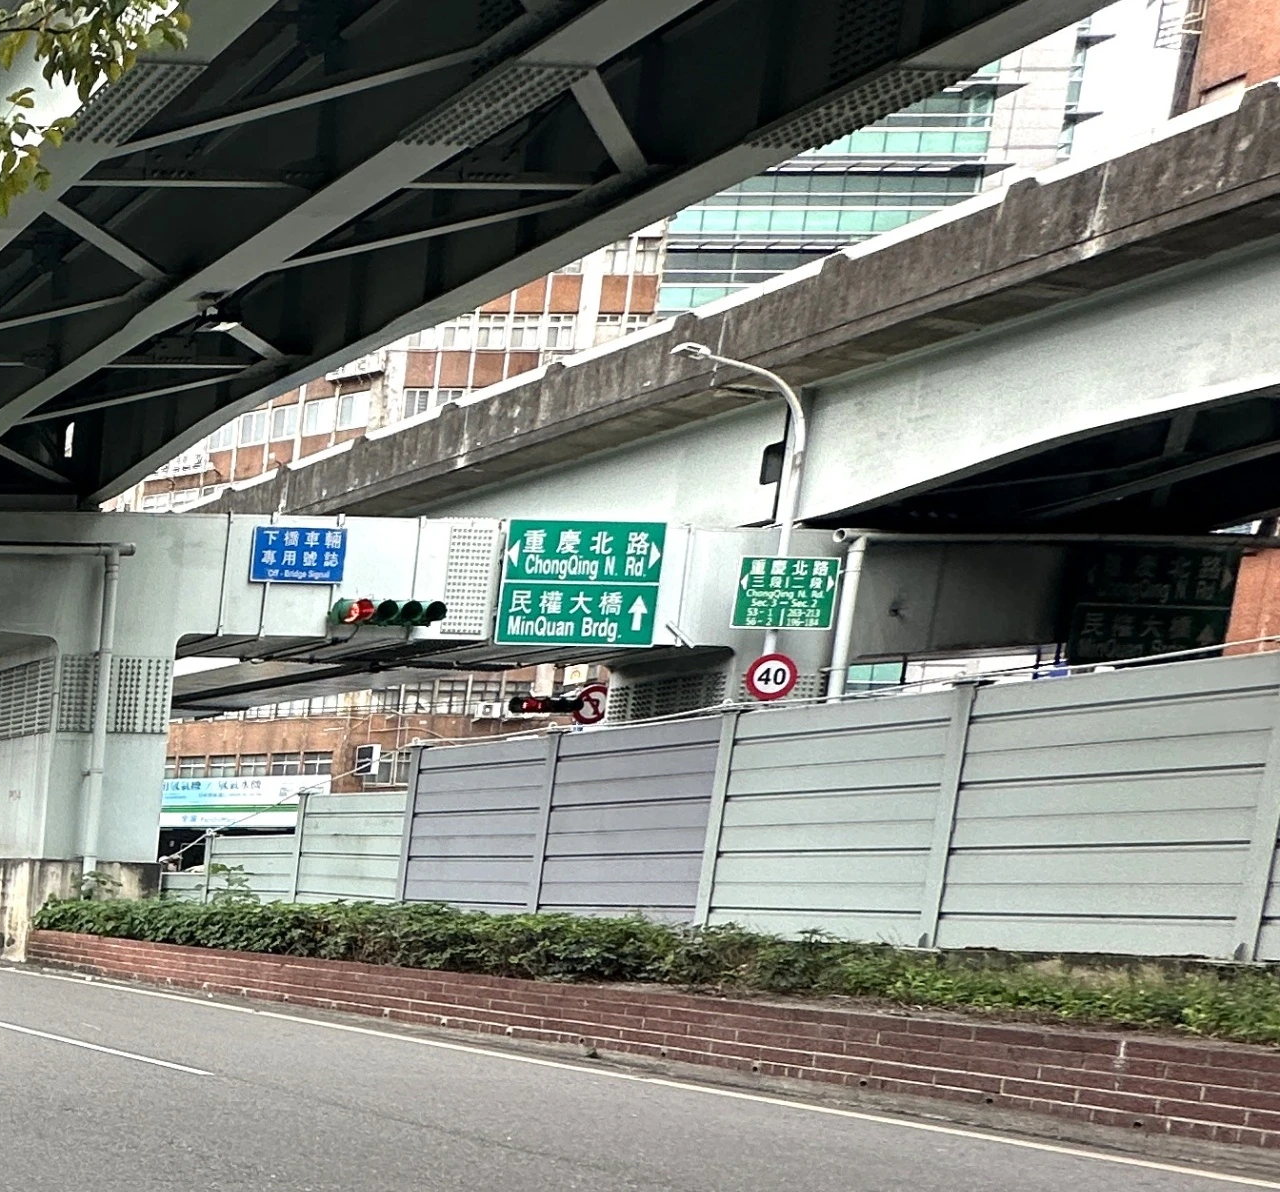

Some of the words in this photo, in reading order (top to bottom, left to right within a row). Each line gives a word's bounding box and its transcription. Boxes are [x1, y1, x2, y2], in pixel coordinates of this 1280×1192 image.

[263, 531, 342, 548] 下橋車輛
[522, 529, 650, 555] 重慶北路
[261, 550, 339, 567] 專用號誌
[525, 554, 599, 580] ChongQing
[604, 556, 618, 576] N.
[625, 556, 646, 577] Rd.
[284, 569, 307, 579] Bridge
[308, 570, 330, 579] Signal
[750, 559, 829, 576] 重慶北路
[752, 576, 782, 588] 三段
[791, 577, 823, 589] 二段
[509, 590, 623, 615] 民權大橋
[746, 589, 794, 600] ChongQing
[771, 598, 777, 607] 3
[810, 599, 818, 608] 2
[507, 615, 574, 637] MinQuan
[581, 616, 622, 643] Brdg.
[757, 668, 786, 685] 40
